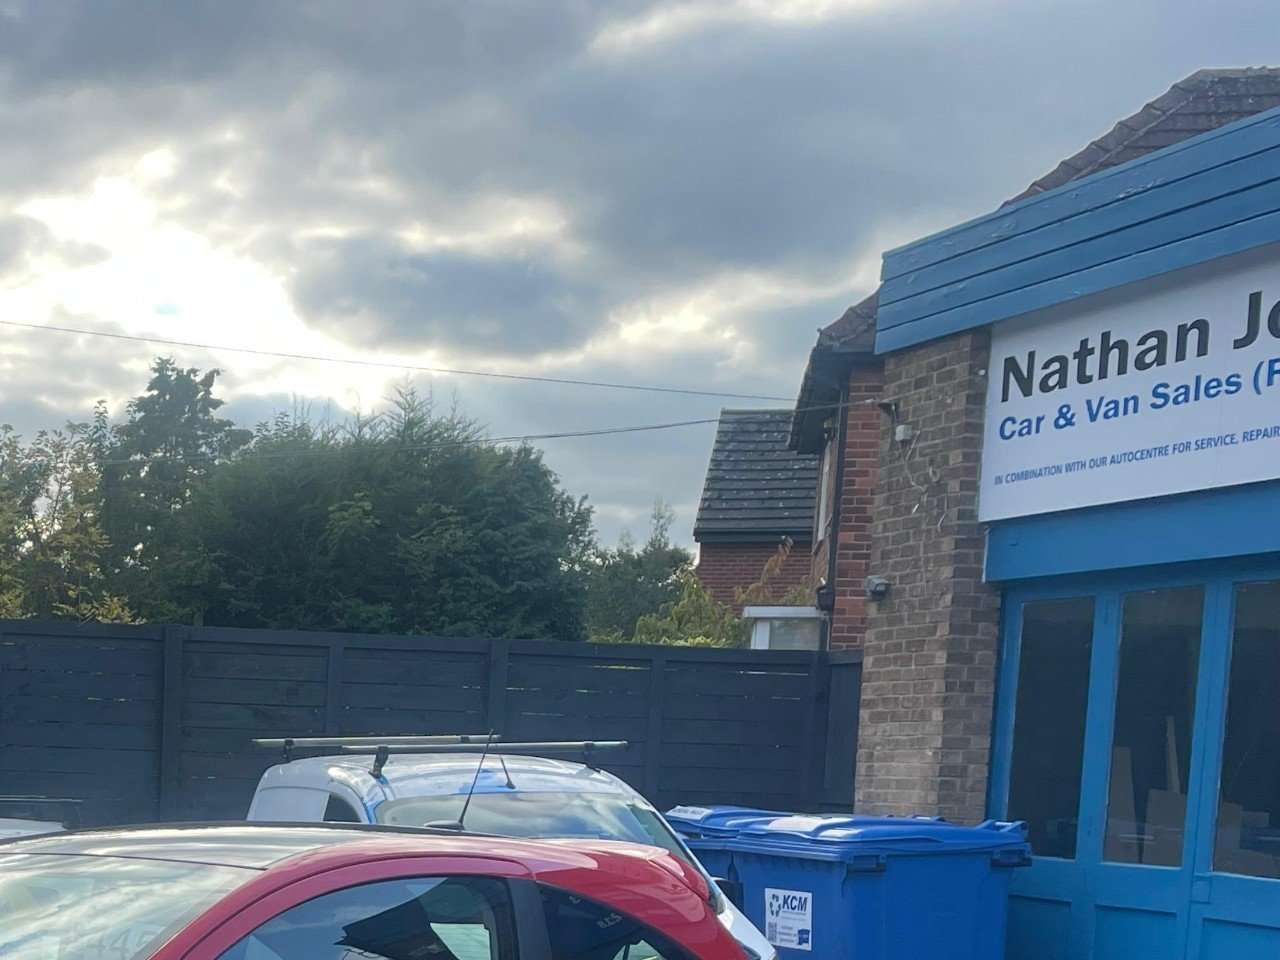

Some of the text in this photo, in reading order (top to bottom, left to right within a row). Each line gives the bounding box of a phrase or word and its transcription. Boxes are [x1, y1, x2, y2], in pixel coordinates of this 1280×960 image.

[1000, 317, 1210, 403] Nathan
[999, 414, 1045, 441] Car
[1053, 404, 1076, 430] &
[1086, 395, 1140, 424] Van
[1150, 373, 1242, 410] Sales
[994, 475, 1004, 486] IN
[1005, 464, 1063, 485] COMBINATION
[1065, 459, 1087, 473] WITH
[1088, 456, 1108, 469] OUR
[1109, 444, 1170, 466] AUTOCENTRE
[1172, 440, 1192, 455] FOR
[782, 894, 808, 912] KCM
